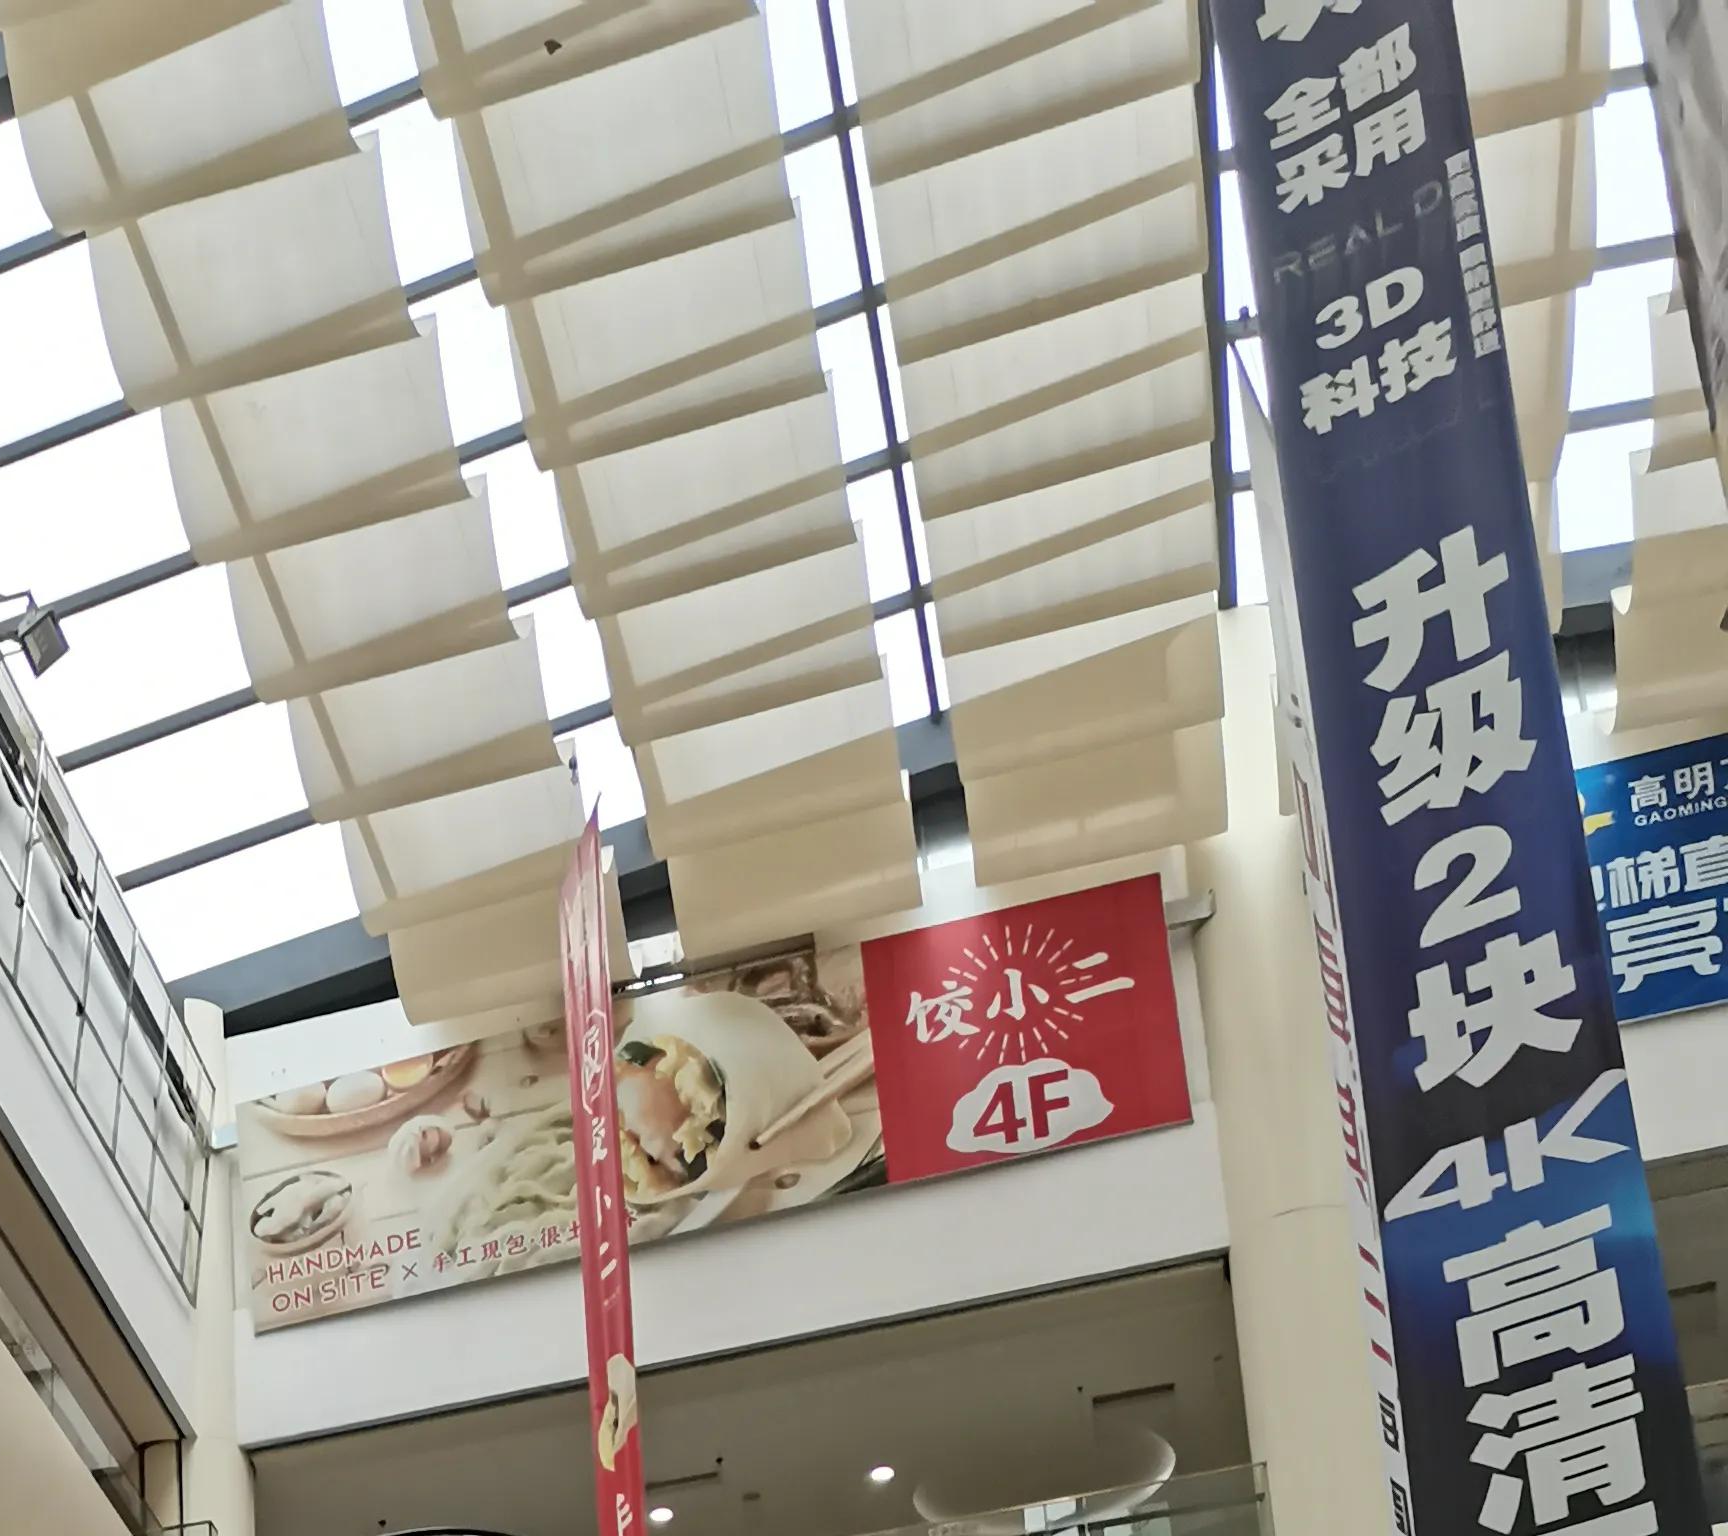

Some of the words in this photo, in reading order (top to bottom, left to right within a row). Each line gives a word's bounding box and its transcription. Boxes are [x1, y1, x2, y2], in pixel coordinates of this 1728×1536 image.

[1264, 22, 1417, 149] 全部
[1275, 91, 1427, 214] 采用
[1315, 266, 1425, 349] 3D
[1299, 317, 1459, 435] 科技
[1627, 757, 1728, 813] 高明
[905, 952, 1135, 1044] 饺小二
[973, 1069, 1070, 1145] 4F
[267, 1228, 422, 1285] HANDMADE
[271, 1291, 313, 1313] ON
[320, 1273, 387, 1304] SITE
